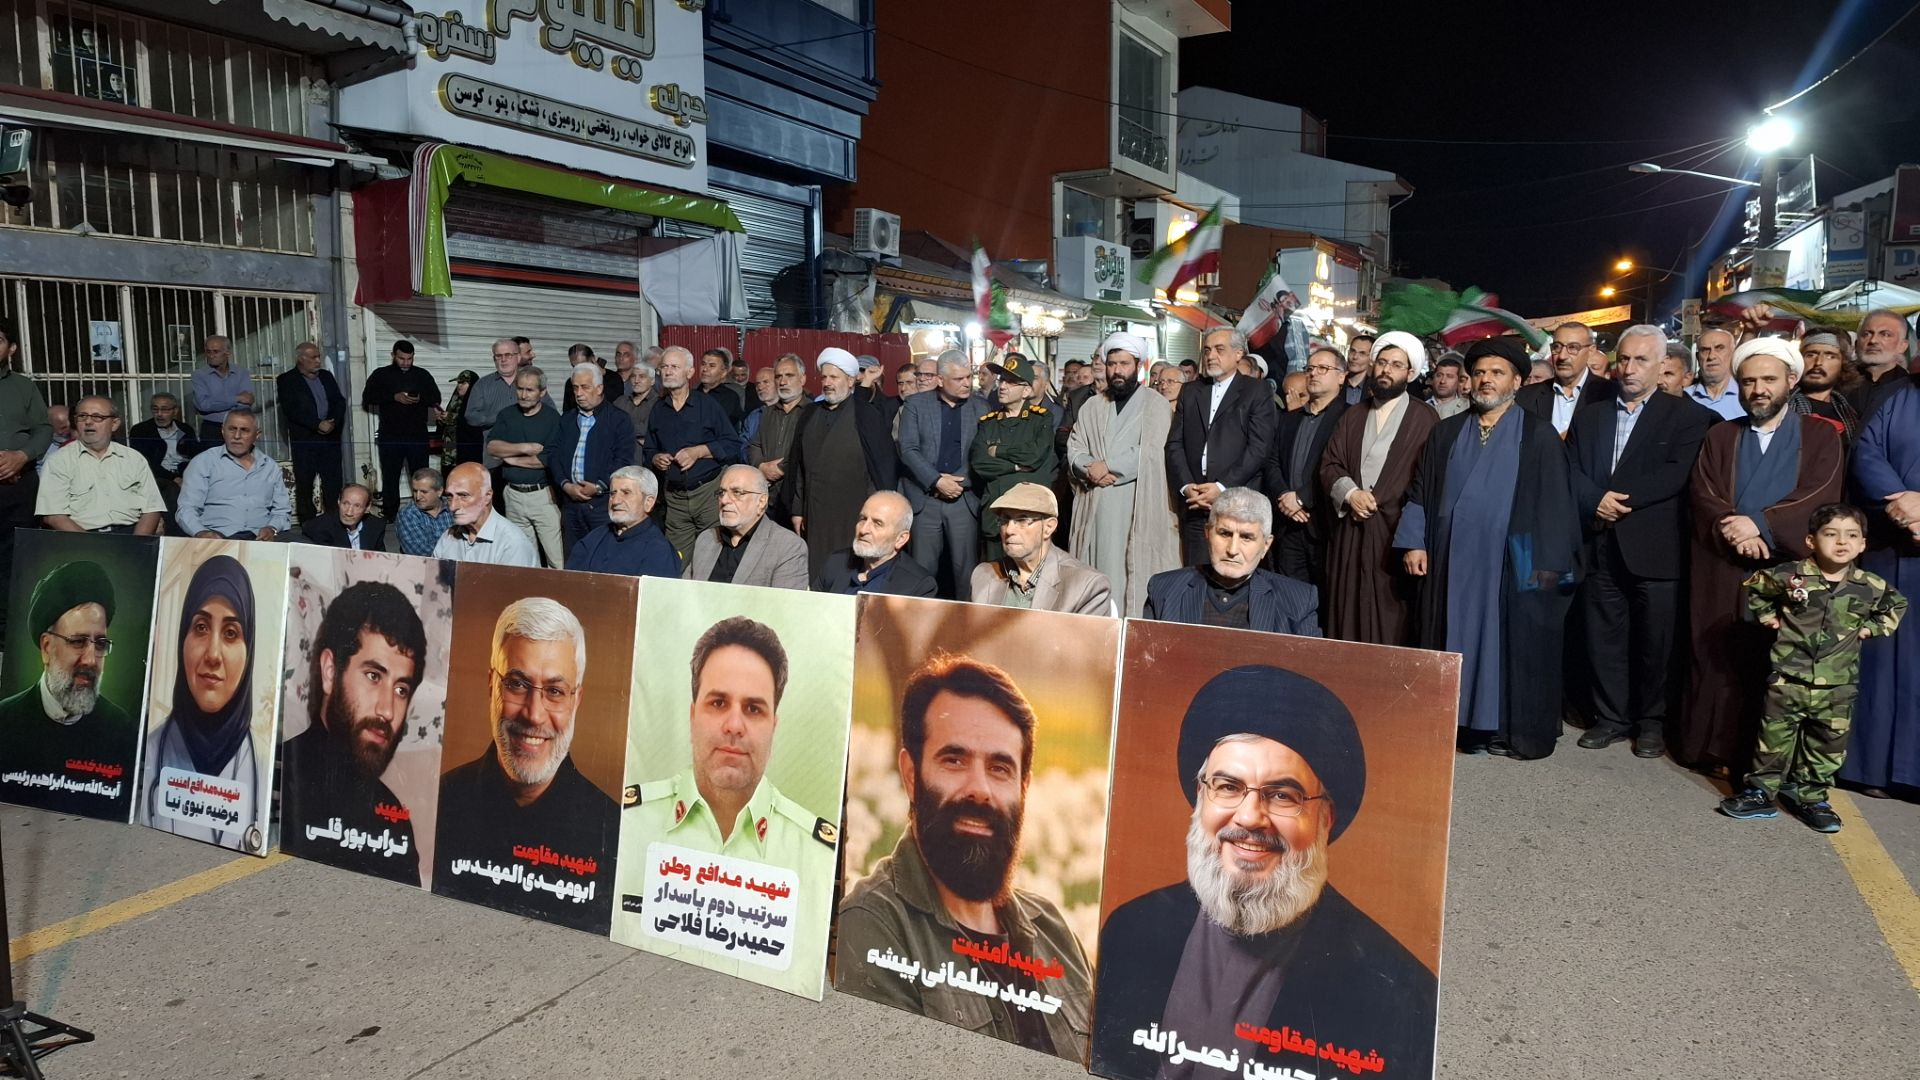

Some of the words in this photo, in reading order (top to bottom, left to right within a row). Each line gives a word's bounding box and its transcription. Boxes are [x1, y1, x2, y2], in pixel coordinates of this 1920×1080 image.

[418, 10, 496, 62] سفره
[454, 87, 485, 108] کوسن
[652, 82, 707, 126] حوله
[651, 133, 671, 151] کالای
[673, 140, 691, 158] انواع
[2, 770, 31, 786] رئیسی
[29, 773, 65, 791] ابراهیم
[95, 762, 122, 779] شهید
[64, 779, 85, 793] سید
[167, 775, 190, 790] امنیت
[165, 790, 181, 812] نیا
[182, 799, 204, 818] نبوی
[375, 802, 411, 823] شهید
[206, 804, 239, 826] مرضیه
[367, 829, 409, 857] تراب
[512, 844, 559, 866] مقاومت
[560, 854, 597, 876] شهید
[451, 858, 524, 886] المهندس
[659, 856, 692, 881] وطن
[695, 862, 743, 888] مدافع
[654, 881, 706, 911] پاسدار
[745, 877, 791, 901] شهید
[707, 898, 735, 917] دوم
[737, 905, 788, 930] سرتیپ
[654, 911, 703, 934] فلاحی
[951, 936, 1010, 964] امنیت
[866, 946, 921, 984] پیشه
[1008, 951, 1065, 982] شهید
[921, 961, 999, 998] سلمانی
[999, 983, 1063, 1015] حمید
[1234, 1022, 1317, 1058] مقاومت
[1318, 1043, 1385, 1075] شهید
